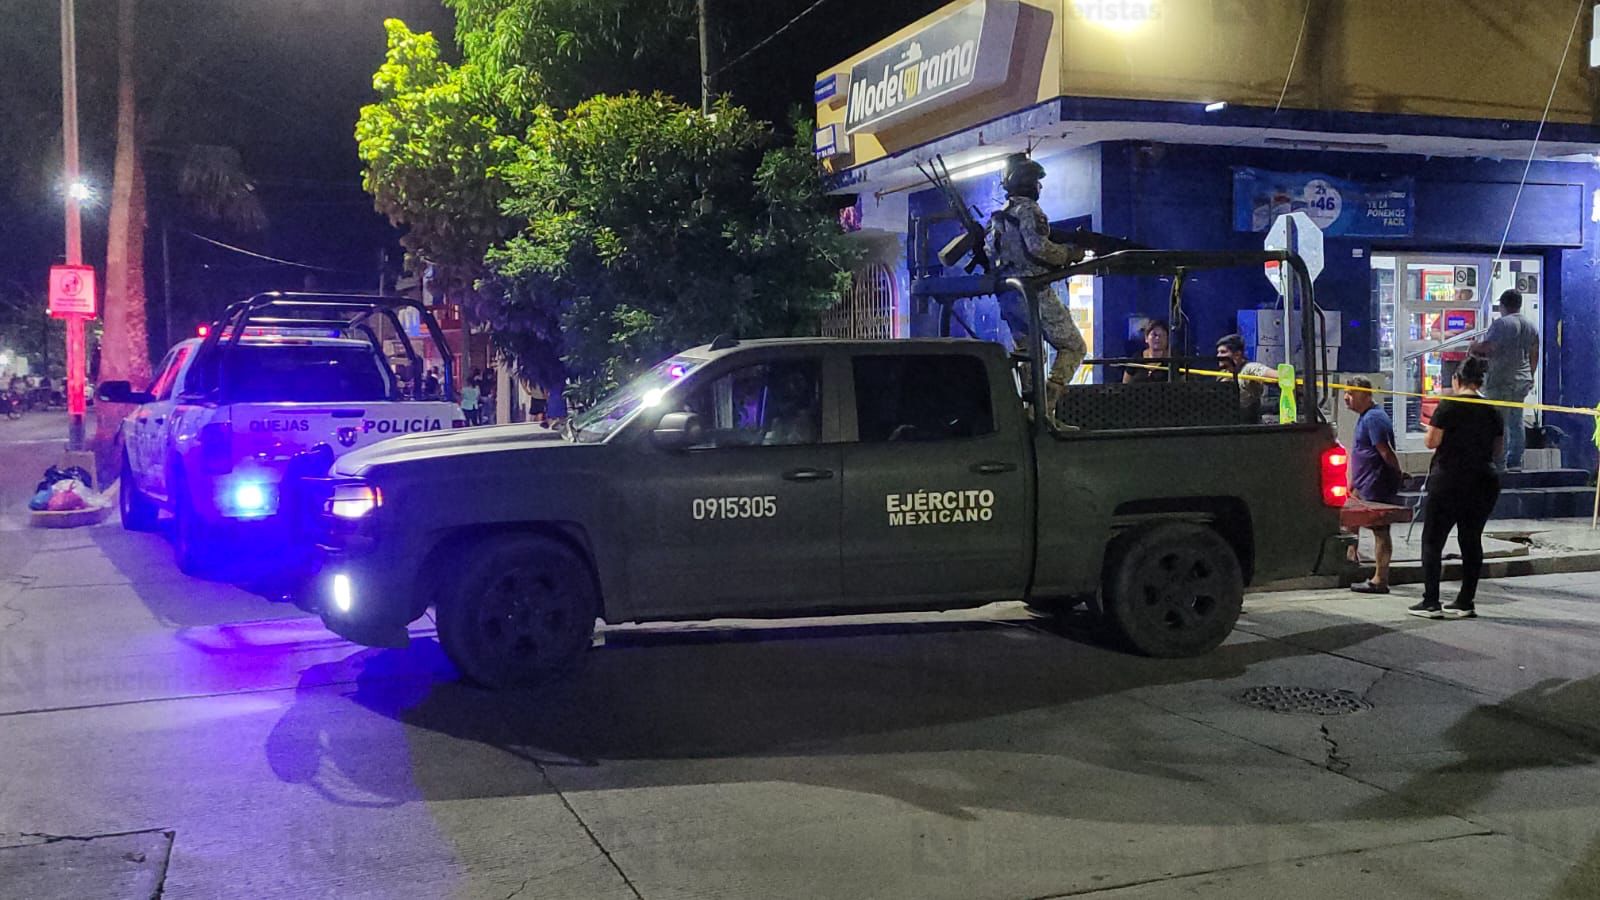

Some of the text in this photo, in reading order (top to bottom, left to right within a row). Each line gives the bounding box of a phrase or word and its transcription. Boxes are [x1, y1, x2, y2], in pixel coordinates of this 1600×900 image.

[250, 419, 310, 432] QUEJAS
[364, 416, 442, 433] POLICÍA
[692, 495, 777, 520] 0915305
[886, 489, 995, 512] EJÉRCITO
[888, 507, 993, 526] MEXICANO
